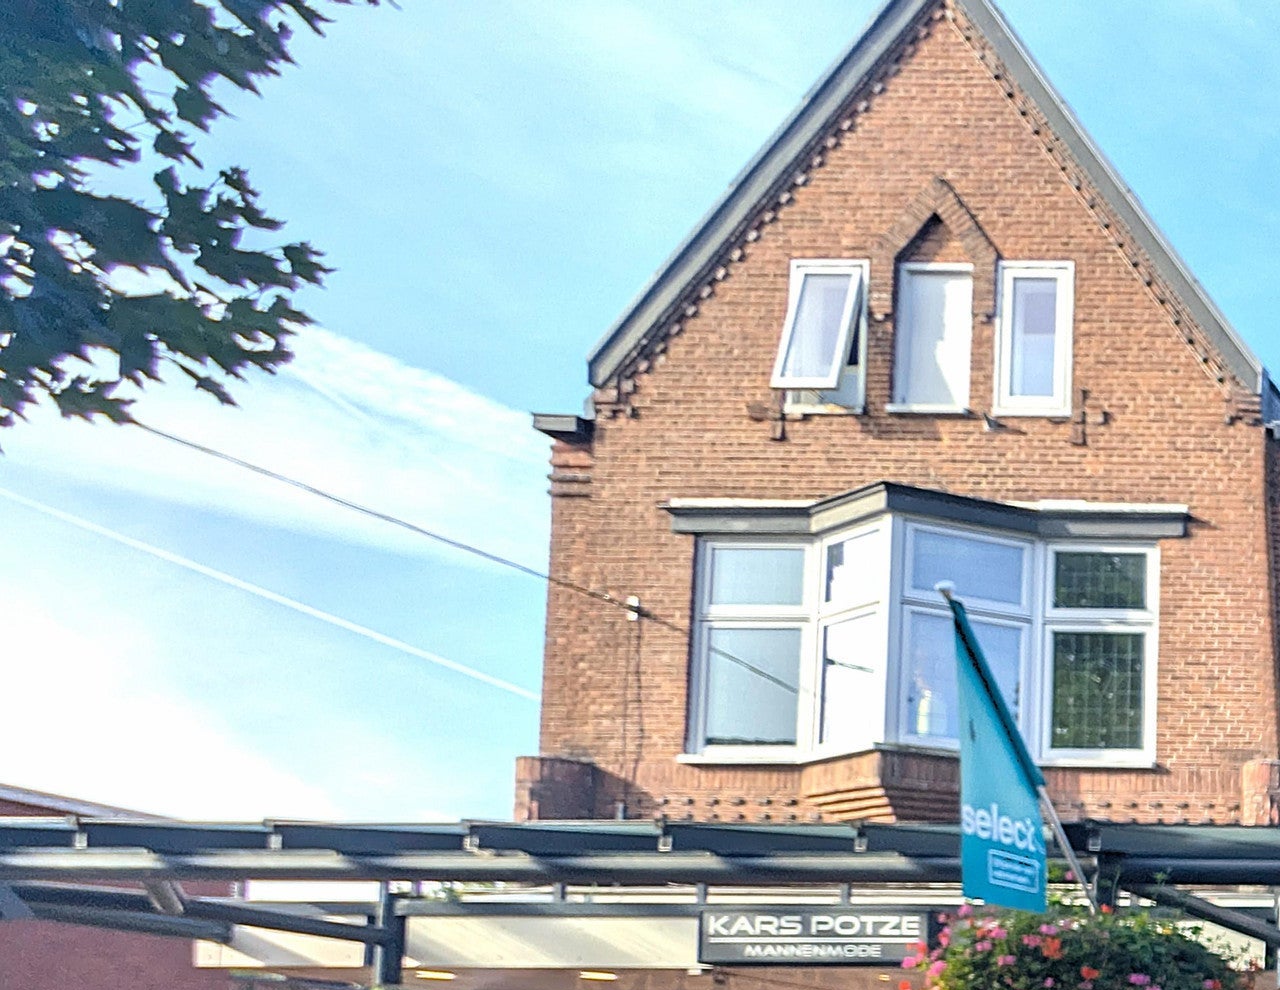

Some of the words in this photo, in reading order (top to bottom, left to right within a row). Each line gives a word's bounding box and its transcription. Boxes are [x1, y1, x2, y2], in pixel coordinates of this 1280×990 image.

[962, 802, 1036, 852] select
[708, 915, 802, 936] KARS
[810, 915, 921, 936] POTZE
[744, 944, 882, 958] MANNENMODE
